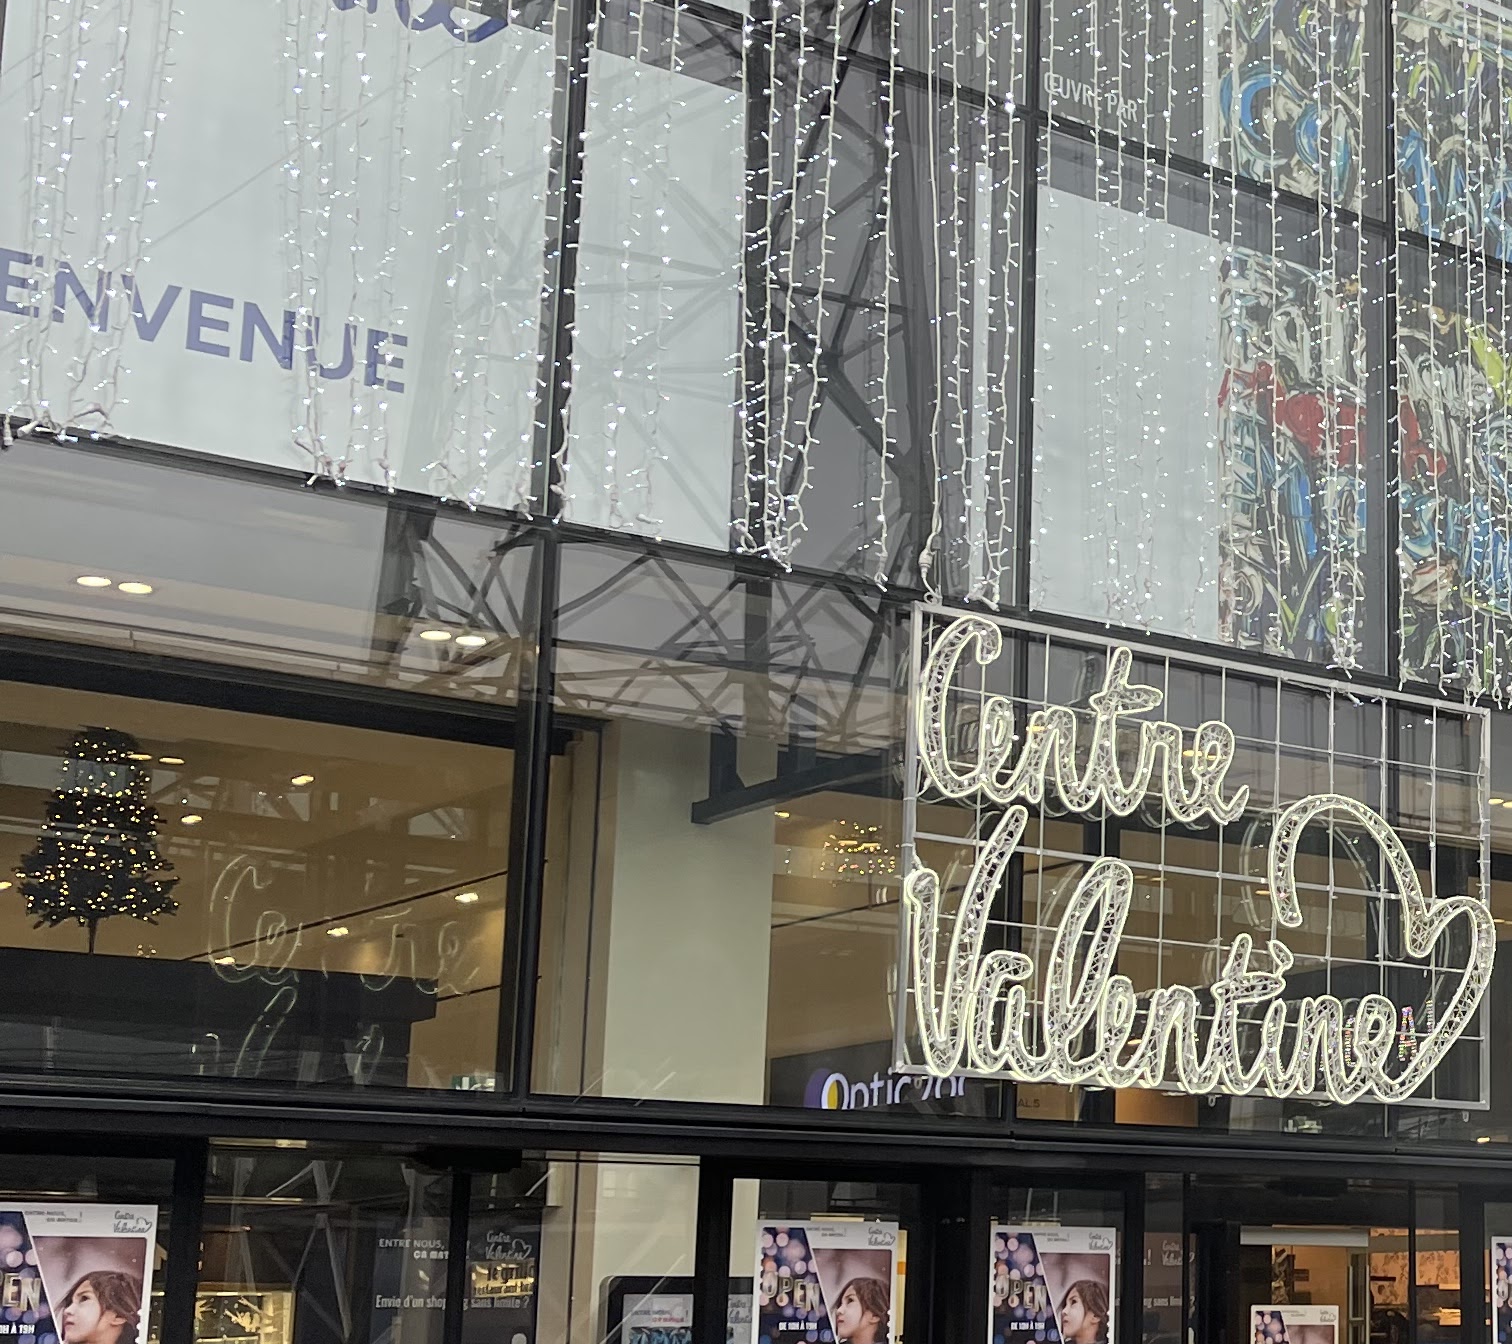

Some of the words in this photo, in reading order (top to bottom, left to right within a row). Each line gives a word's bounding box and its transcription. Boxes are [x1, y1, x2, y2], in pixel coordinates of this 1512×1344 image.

[918, 614, 1250, 826] Centre
[904, 793, 1496, 1104] Valentine
[2, 1273, 41, 1312] EN
[761, 1271, 821, 1315] OPEN
[995, 1273, 1048, 1317] OPEN
